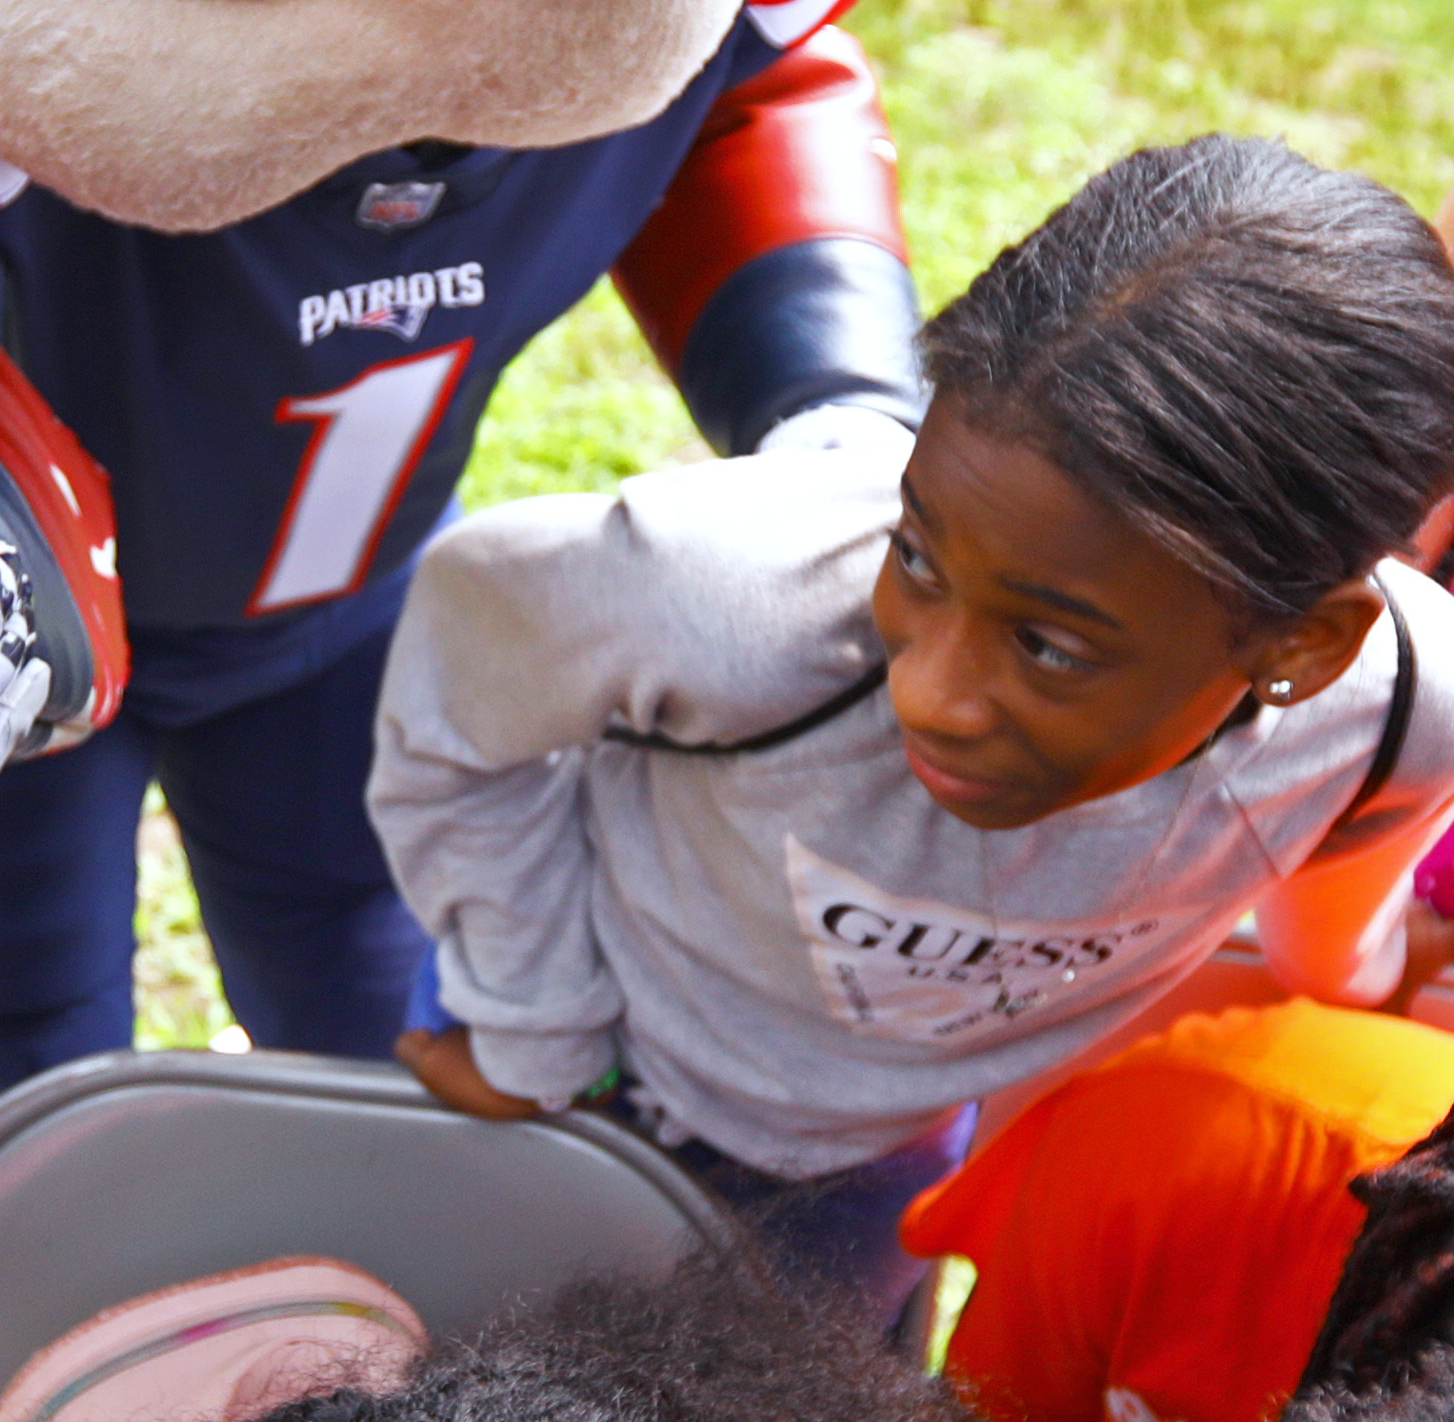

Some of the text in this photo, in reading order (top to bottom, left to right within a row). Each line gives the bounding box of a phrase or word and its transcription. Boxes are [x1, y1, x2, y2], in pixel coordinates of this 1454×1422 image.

[298, 261, 485, 345] PATRIOTS
[244, 336, 476, 619] 1
[823, 903, 1123, 968] GUESS
